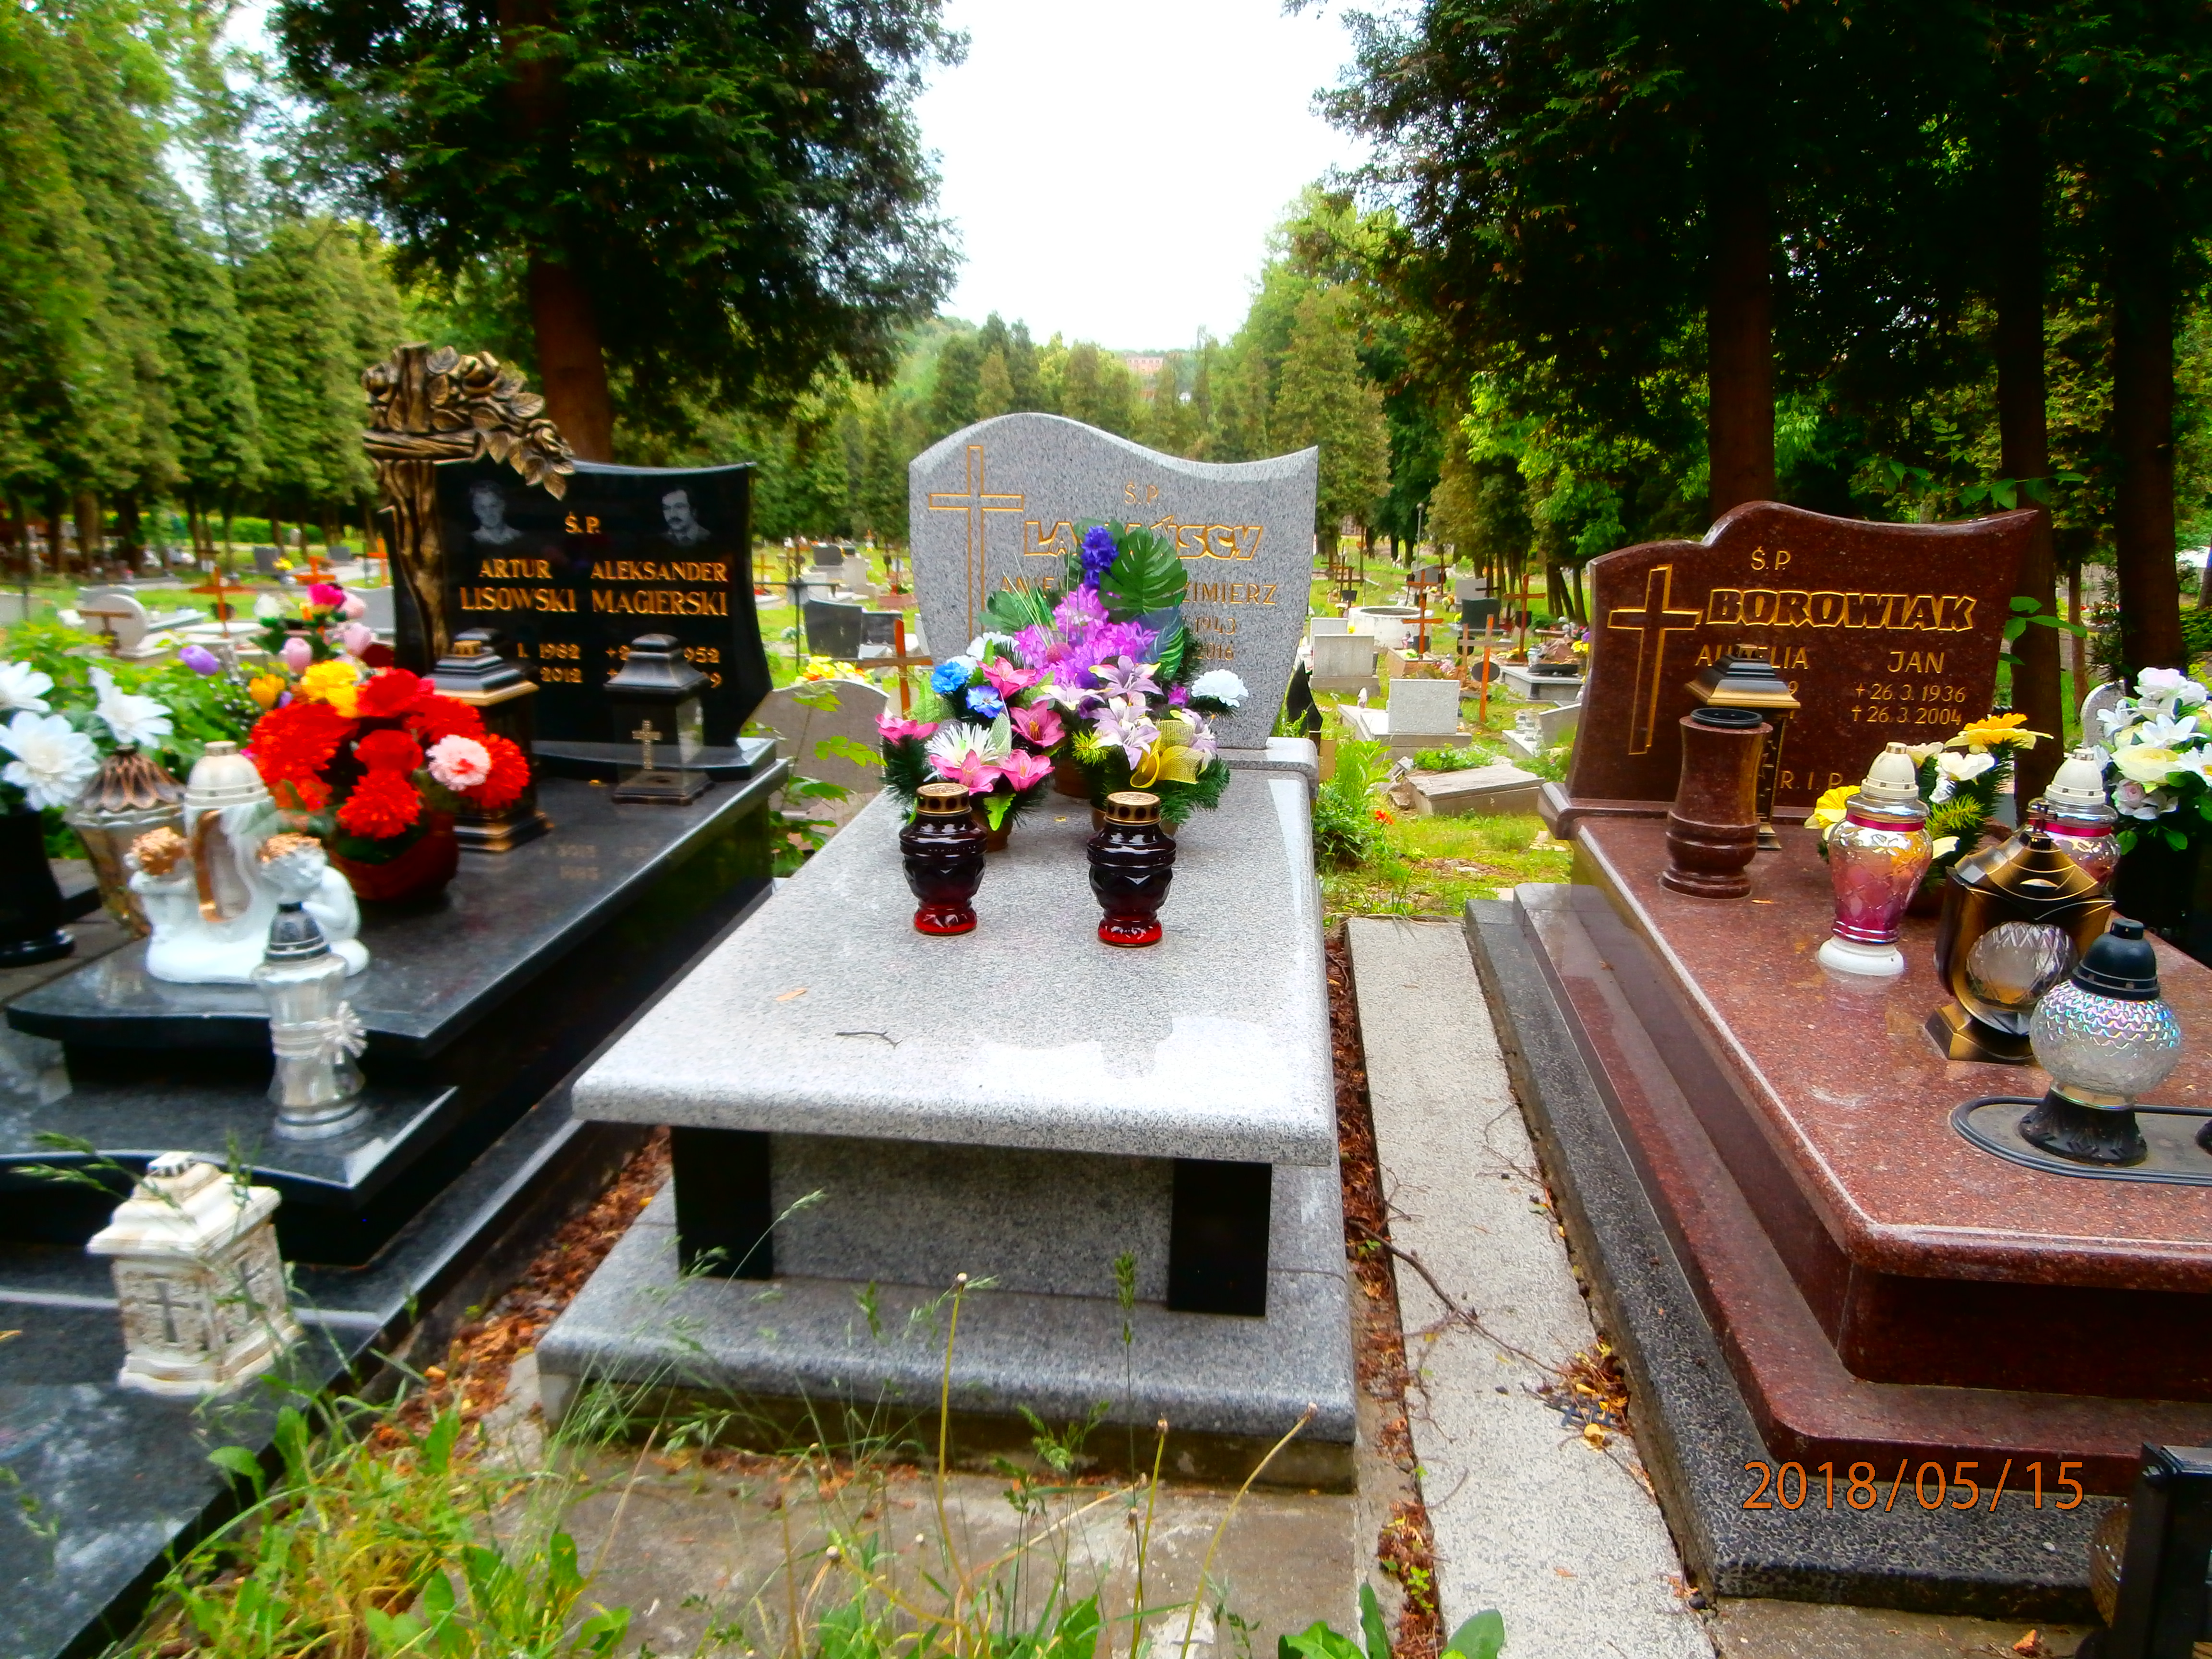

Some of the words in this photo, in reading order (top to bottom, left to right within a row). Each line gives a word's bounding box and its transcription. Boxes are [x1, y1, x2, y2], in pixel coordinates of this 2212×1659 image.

[479, 558, 553, 579] ARTUR
[590, 560, 729, 583] ALEKSANDER
[459, 587, 577, 613] LISOWSKI
[591, 589, 729, 616] MAGIERSKI
[1706, 589, 1978, 632] BOROWIAK
[1887, 651, 1945, 673] JAN
[540, 666, 584, 683] 2012
